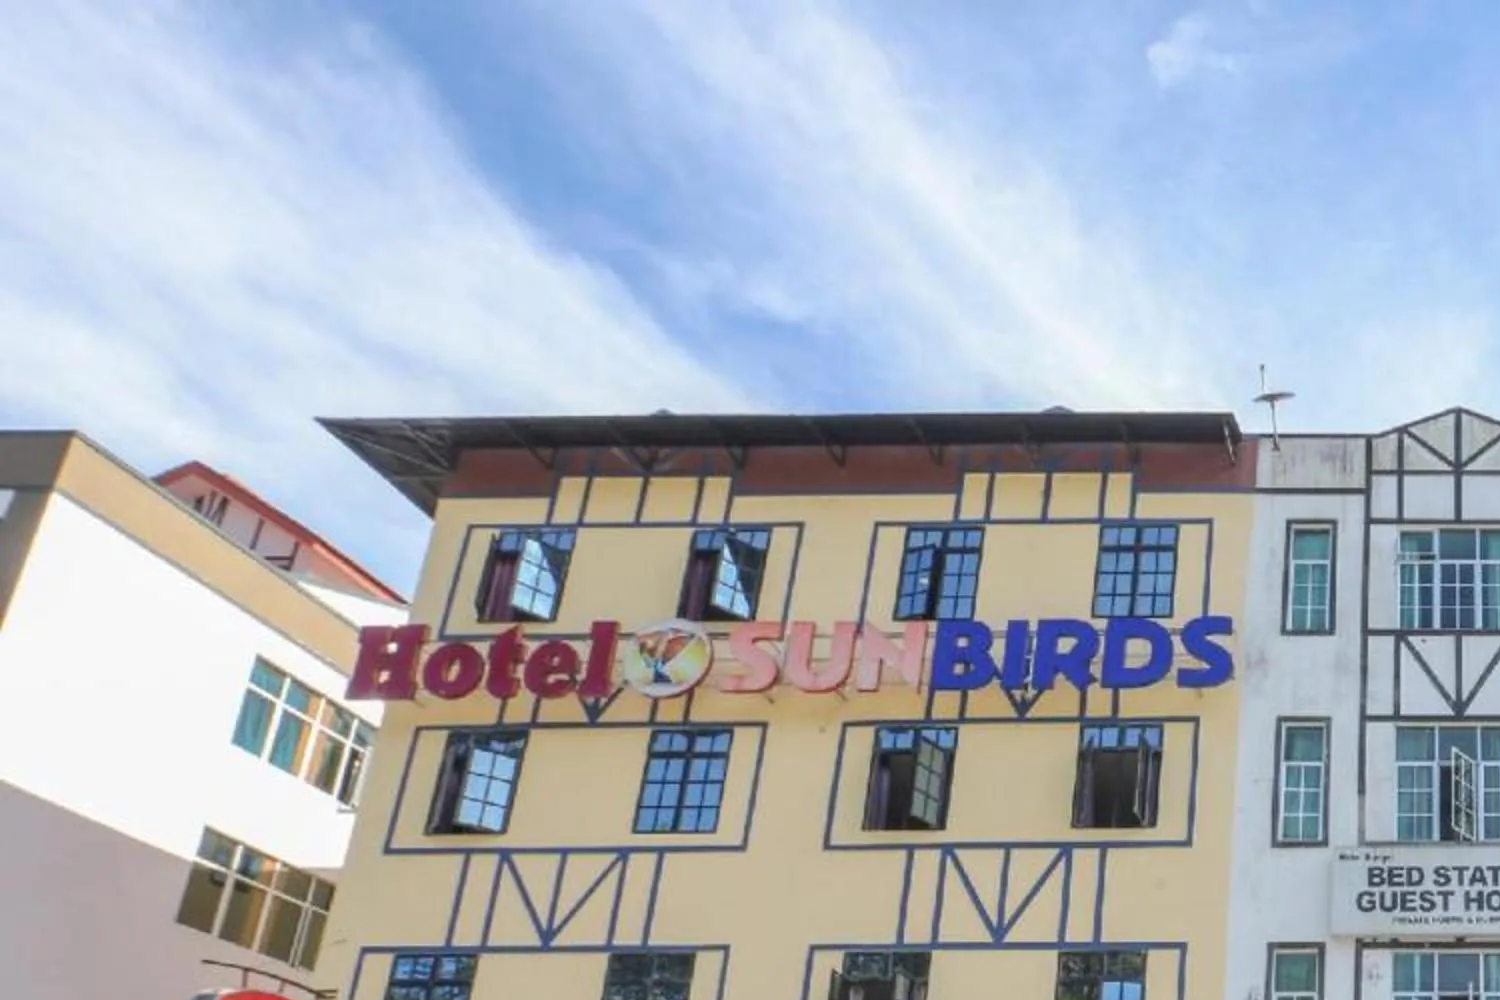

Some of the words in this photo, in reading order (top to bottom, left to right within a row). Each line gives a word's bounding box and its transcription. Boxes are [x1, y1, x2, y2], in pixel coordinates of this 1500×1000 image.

[345, 621, 620, 700] Hotel
[1367, 866, 1425, 887] BED
[1355, 891, 1455, 913] GUEST
